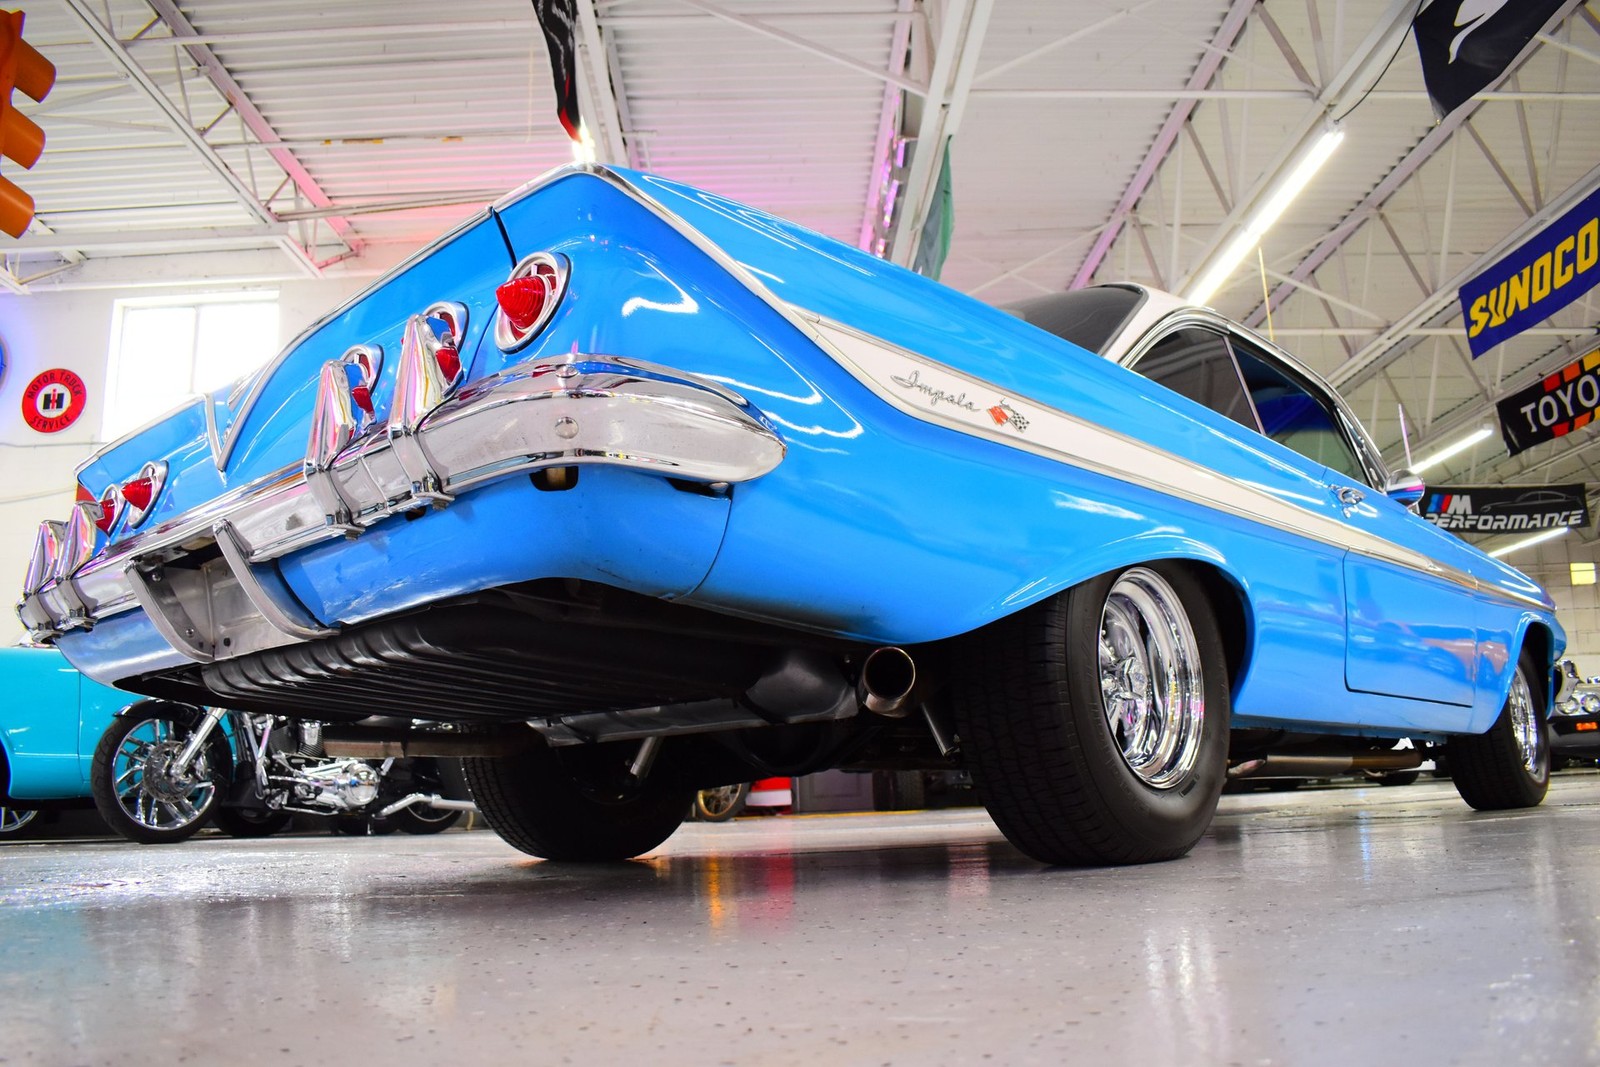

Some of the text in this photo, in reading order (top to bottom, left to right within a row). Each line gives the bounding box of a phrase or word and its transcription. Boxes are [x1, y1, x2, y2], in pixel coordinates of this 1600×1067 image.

[1469, 217, 1599, 338] SUNOCO
[28, 372, 82, 399] MOTOR TRUCK
[890, 370, 981, 412] Impala
[1520, 368, 1600, 433] TOYO
[31, 414, 71, 430] SERVICE
[1424, 509, 1584, 530] PERFORMANCE
